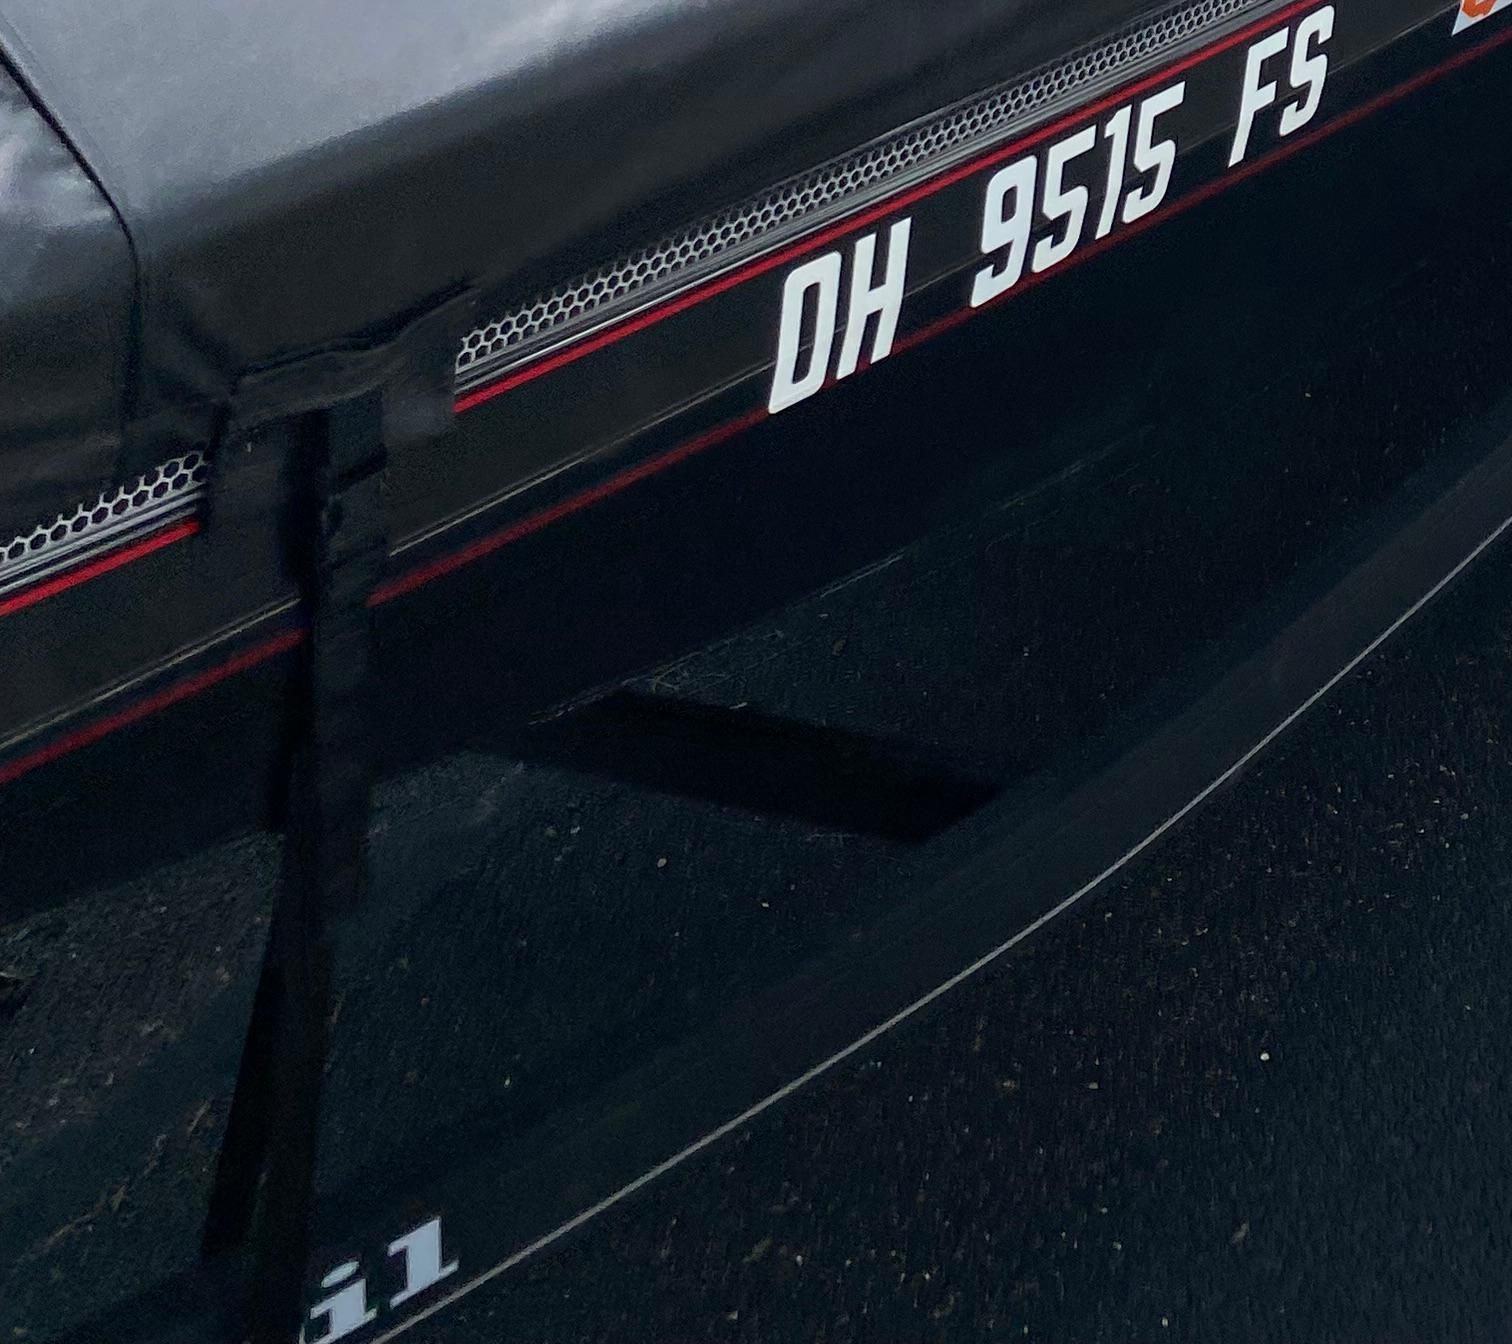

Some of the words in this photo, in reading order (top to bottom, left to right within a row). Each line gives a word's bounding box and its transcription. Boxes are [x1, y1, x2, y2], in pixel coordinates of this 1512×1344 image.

[768, 216, 912, 414] OH
[969, 80, 1186, 308] 9515
[1228, 4, 1335, 169] FS
